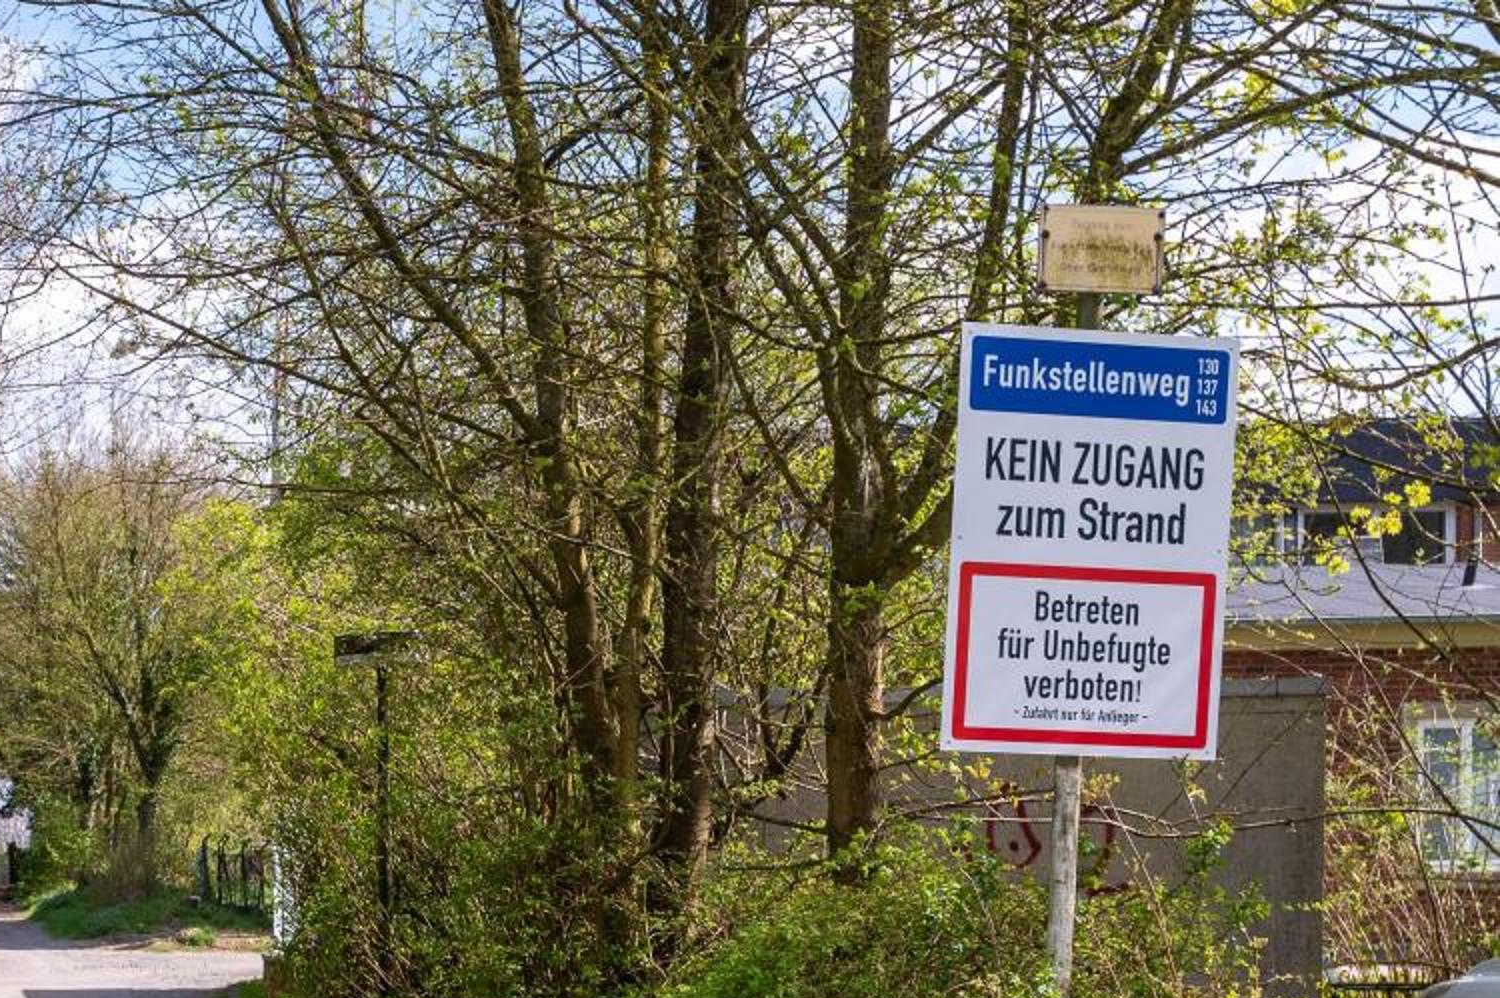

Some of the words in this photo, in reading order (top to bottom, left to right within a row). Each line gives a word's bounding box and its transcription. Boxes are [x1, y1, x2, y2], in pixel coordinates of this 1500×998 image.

[982, 354, 1190, 408] Funkstellenweg
[1198, 357, 1220, 375] 130
[1197, 378, 1219, 396] 137
[1195, 398, 1218, 417] 143
[985, 436, 1061, 484] KEIN
[1071, 441, 1206, 492] ZUGANG
[996, 504, 1066, 539] zum
[1077, 497, 1187, 545] Strand
[1034, 590, 1140, 626] Betreten
[997, 628, 1035, 659] für
[1044, 630, 1172, 673] Unbefugte
[1023, 670, 1142, 703] verboten!
[1022, 705, 1059, 720] Zufahrt
[1061, 710, 1078, 721] nur
[1081, 708, 1096, 721] für
[1098, 710, 1140, 726] Anlieger
